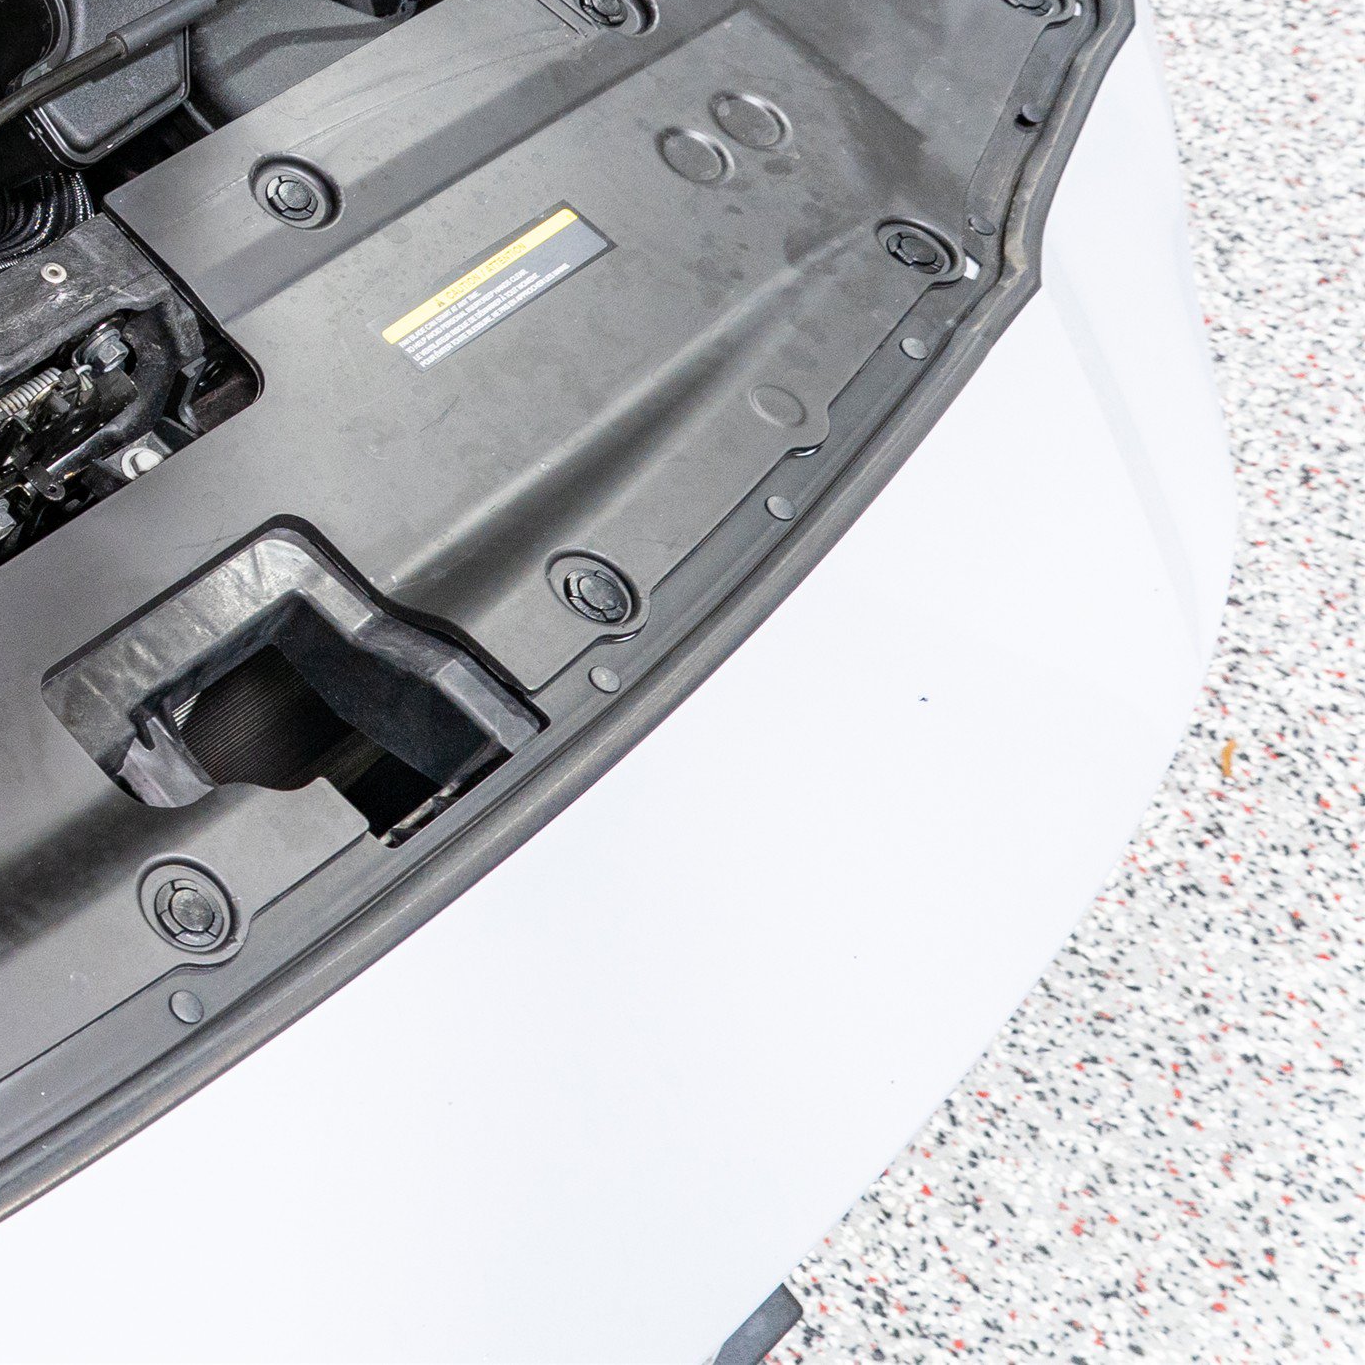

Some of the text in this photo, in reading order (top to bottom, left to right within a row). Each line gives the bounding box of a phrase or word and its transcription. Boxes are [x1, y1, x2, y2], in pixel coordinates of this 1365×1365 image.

[444, 272, 482, 300] CAUTION
[483, 240, 528, 273] ATTENTION
[404, 344, 416, 354] TO
[410, 335, 429, 350] HELP
[423, 325, 443, 341] AVOID
[411, 351, 423, 362] LE
[418, 353, 438, 368] POUR
